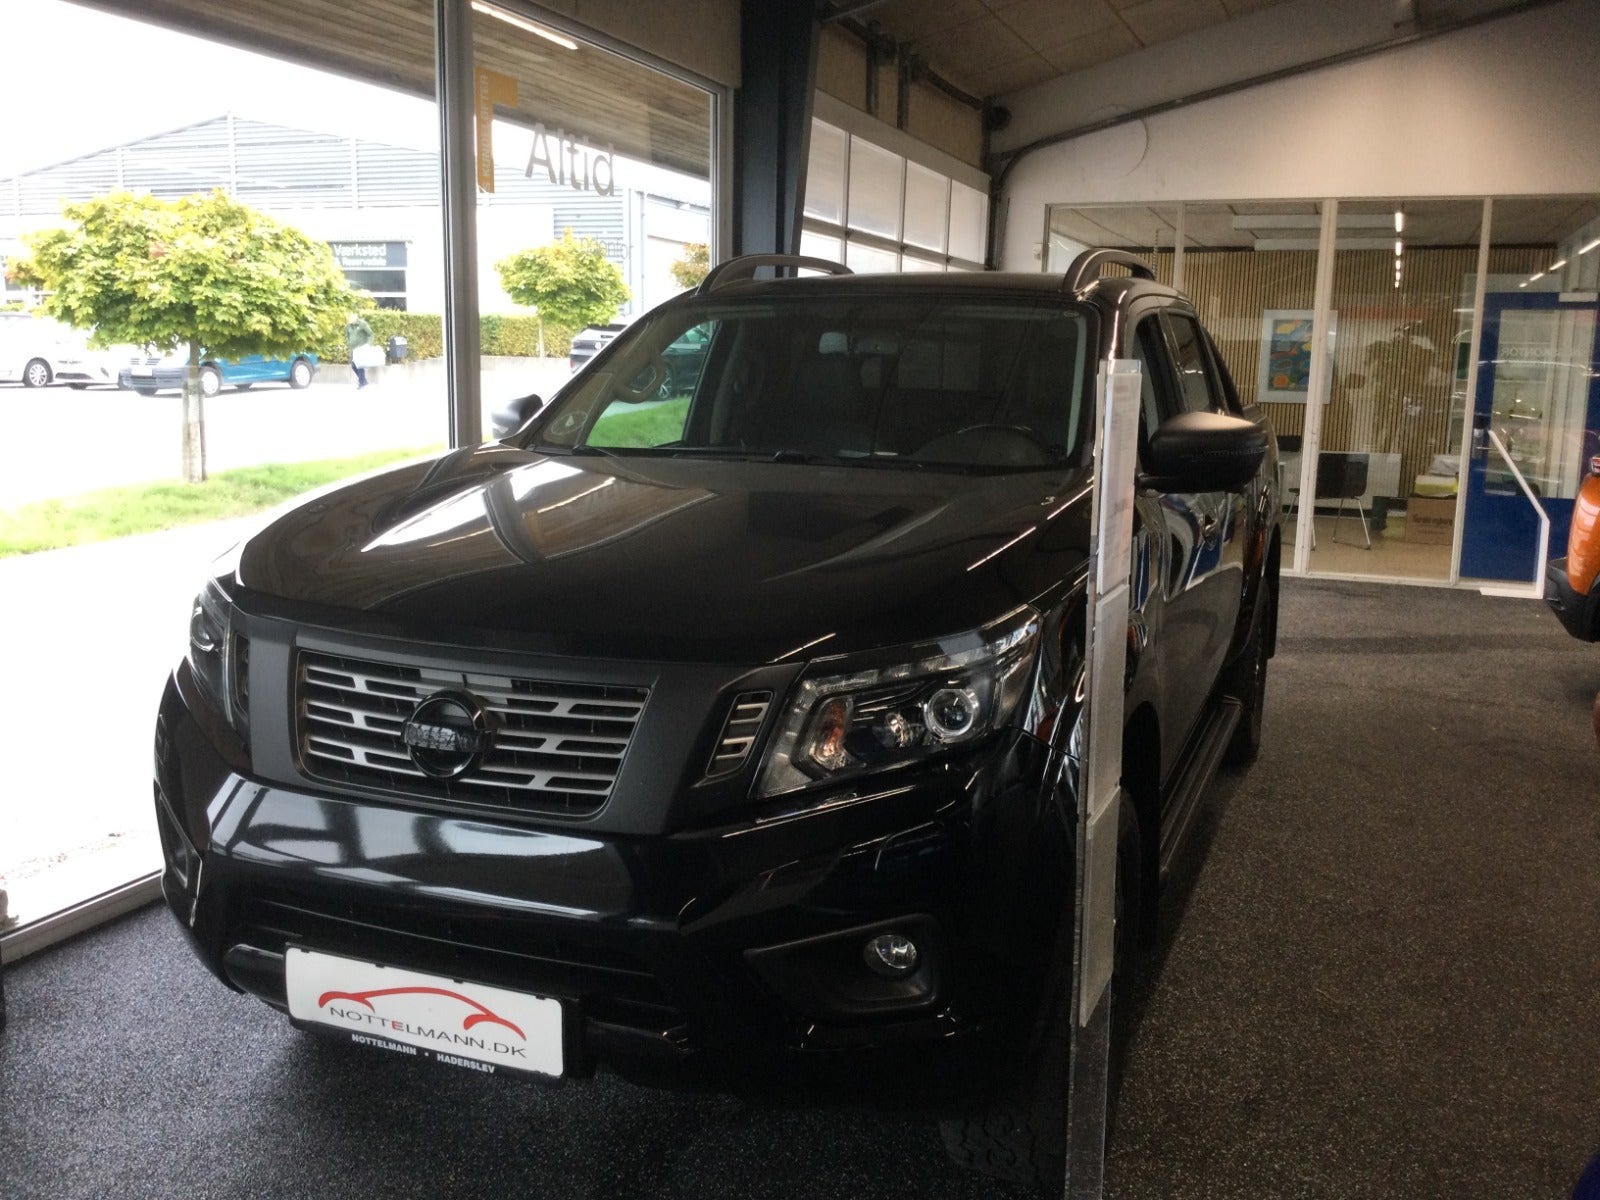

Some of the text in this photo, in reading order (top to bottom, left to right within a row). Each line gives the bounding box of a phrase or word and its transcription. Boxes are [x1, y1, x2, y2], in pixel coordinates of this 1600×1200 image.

[525, 122, 615, 197] Altid
[333, 243, 387, 257] Værksted
[329, 1006, 528, 1059] NOTTELMANN.DK
[351, 1033, 496, 1075] NOTTELMANN HADERSLEV
